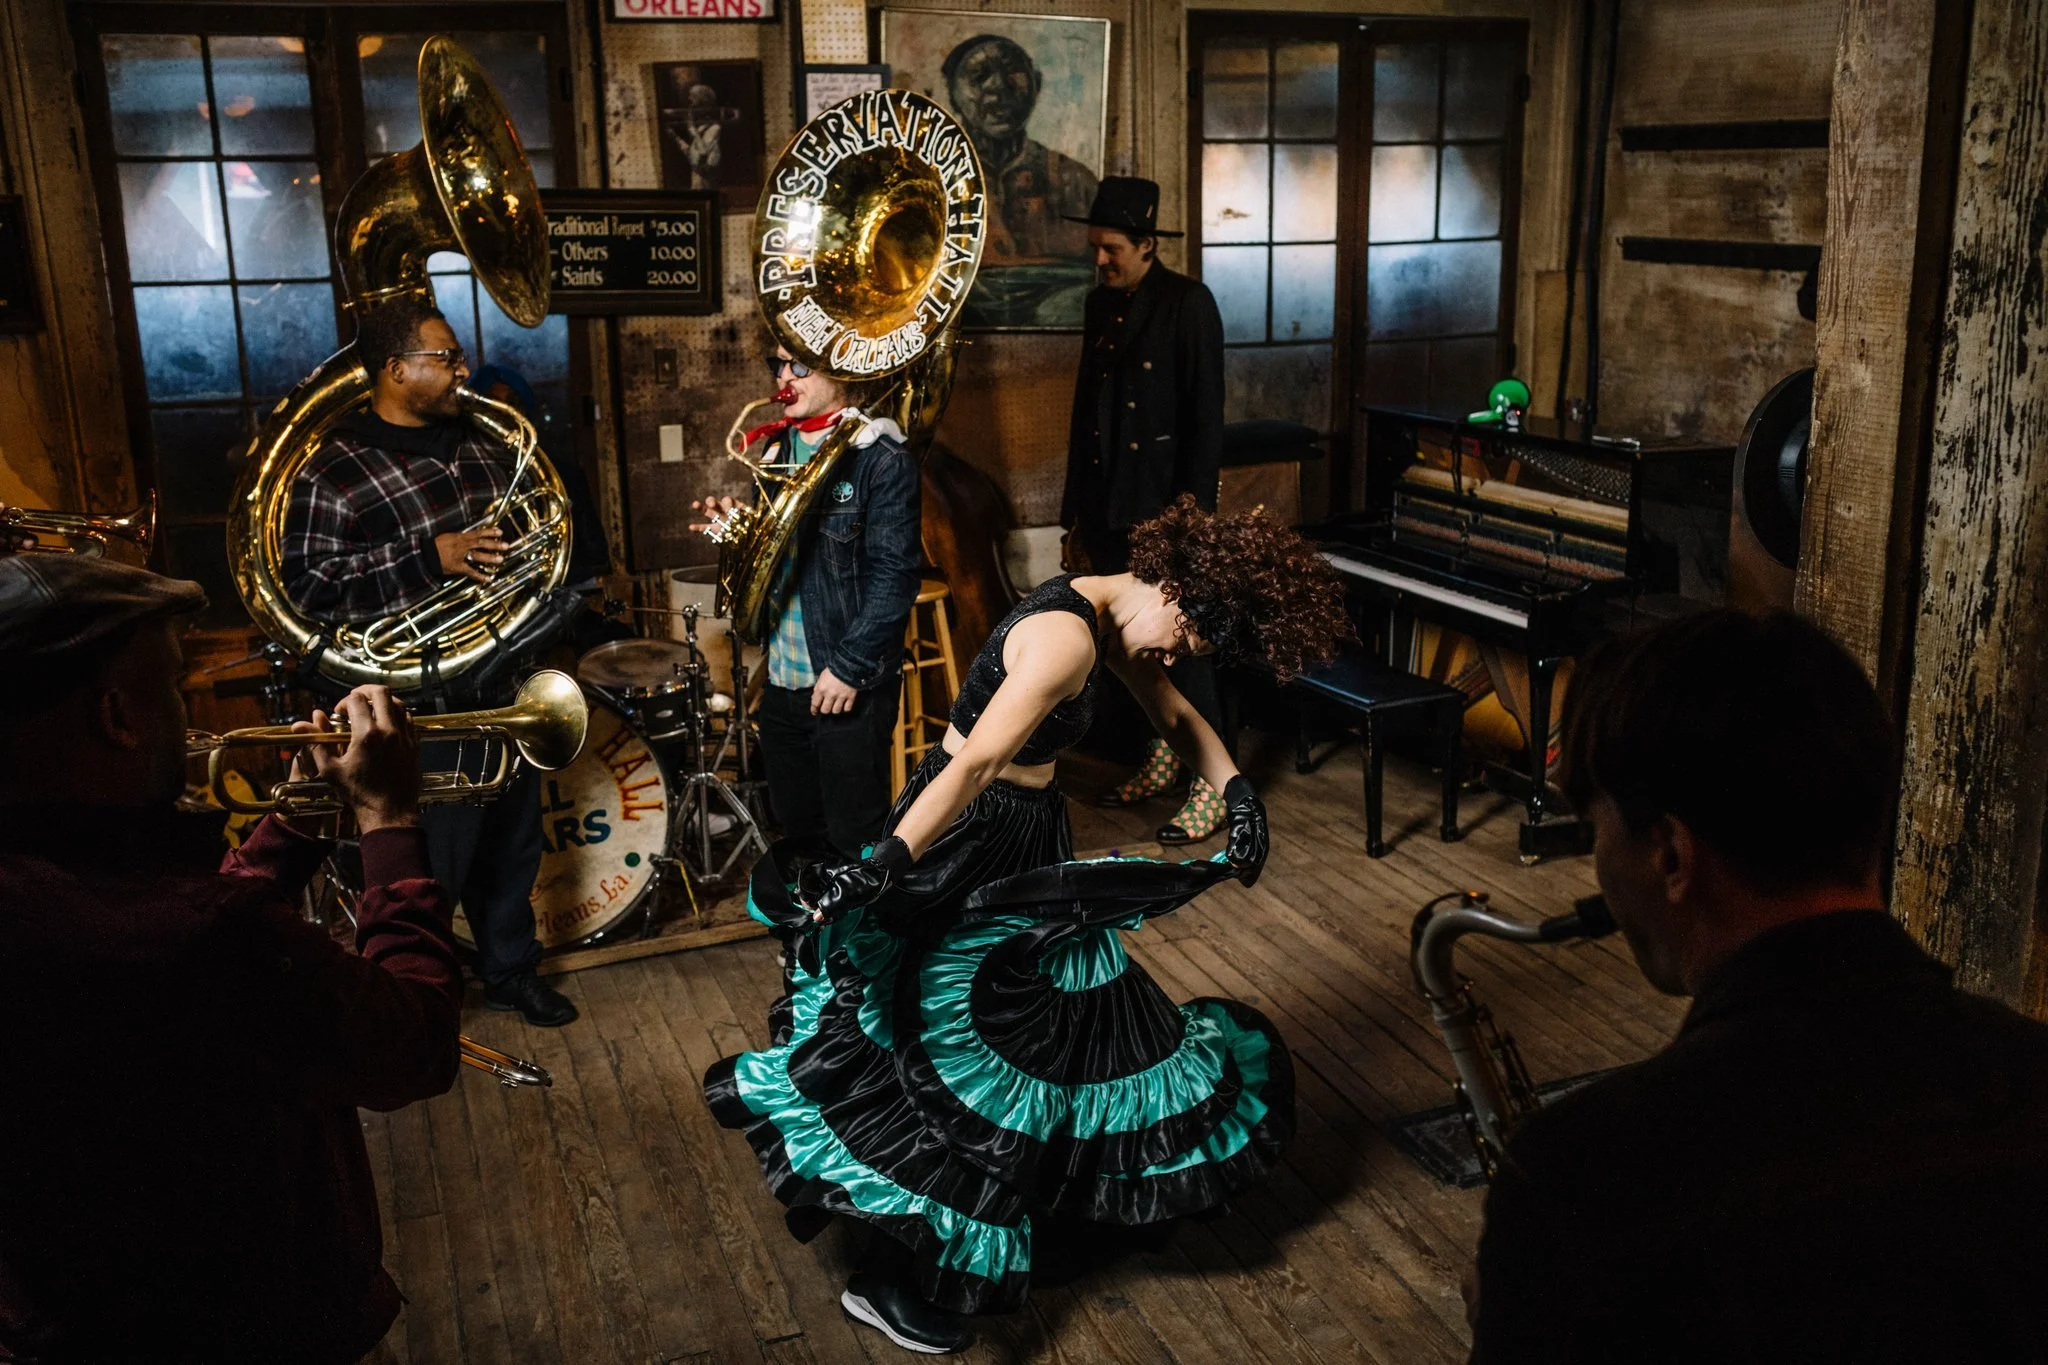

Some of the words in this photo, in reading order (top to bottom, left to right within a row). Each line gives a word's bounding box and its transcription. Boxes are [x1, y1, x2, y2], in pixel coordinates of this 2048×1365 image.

[625, 0, 762, 17] ORLEANS
[561, 241, 609, 262] Others
[650, 246, 697, 261] 10.00
[561, 265, 604, 286] Saints
[646, 270, 697, 286] 20.00
[596, 725, 664, 821] HALL
